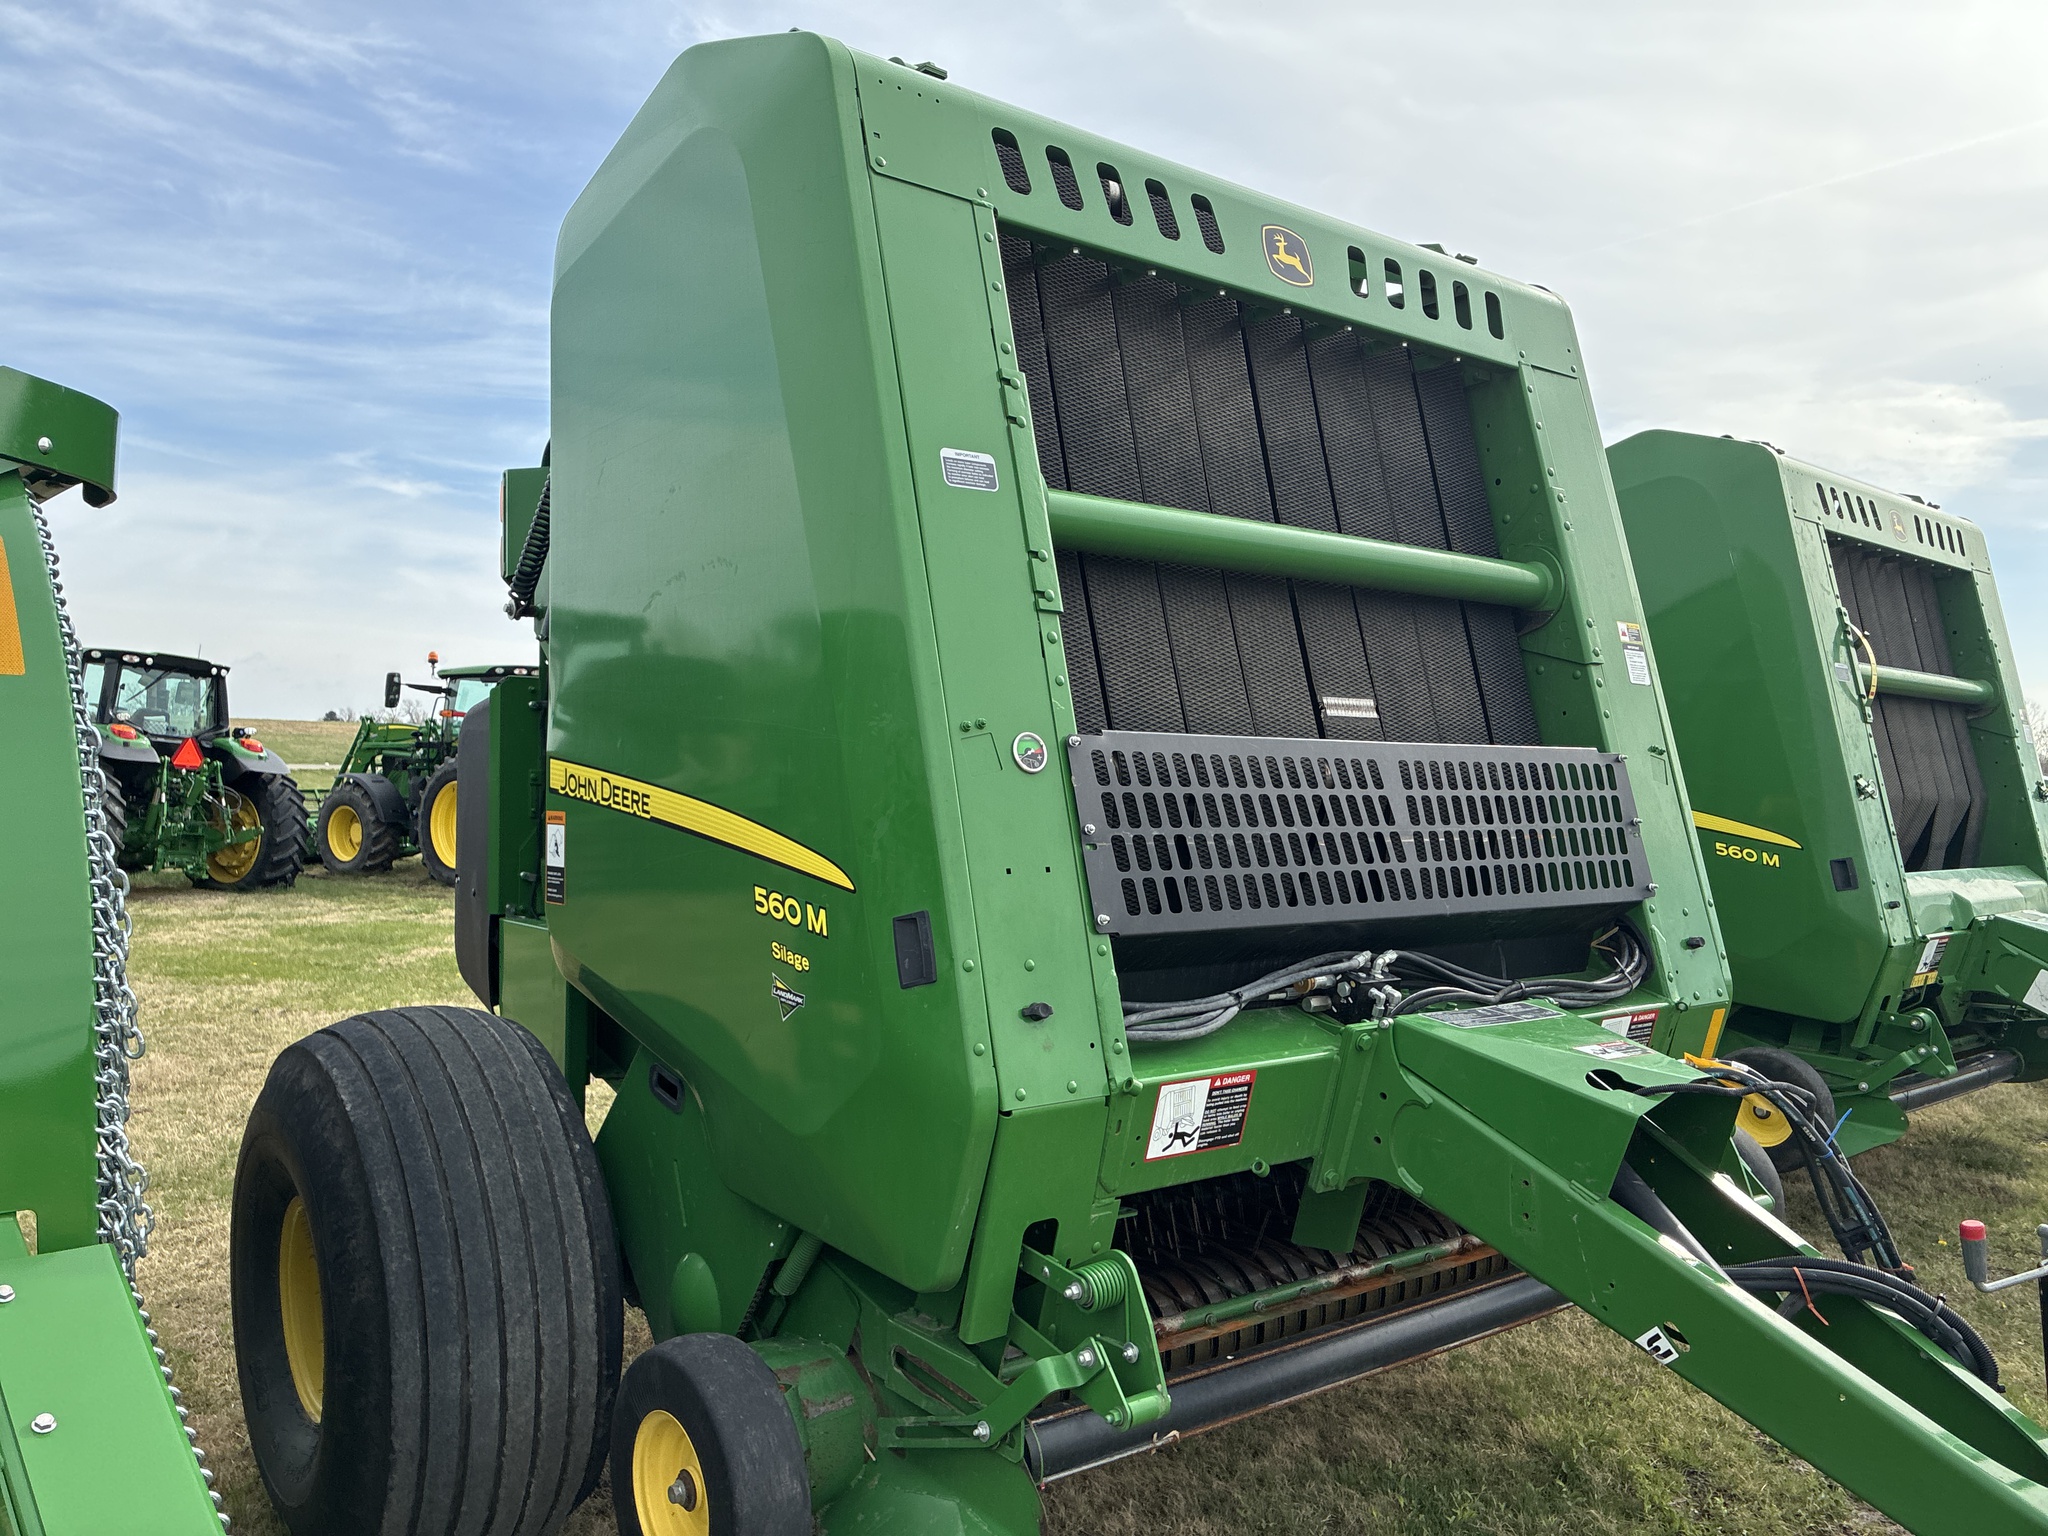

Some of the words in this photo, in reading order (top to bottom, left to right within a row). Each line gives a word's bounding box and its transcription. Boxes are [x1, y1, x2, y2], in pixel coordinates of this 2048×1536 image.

[954, 452, 980, 460] IMPORTANT
[560, 767, 598, 800] JOHN
[600, 776, 651, 816] DEERE
[1714, 841, 1758, 863] 560
[1761, 851, 1780, 868] M
[753, 885, 802, 926] 560
[806, 902, 829, 938] M
[771, 940, 810, 972] Silage
[1222, 1074, 1251, 1086] DANGER
